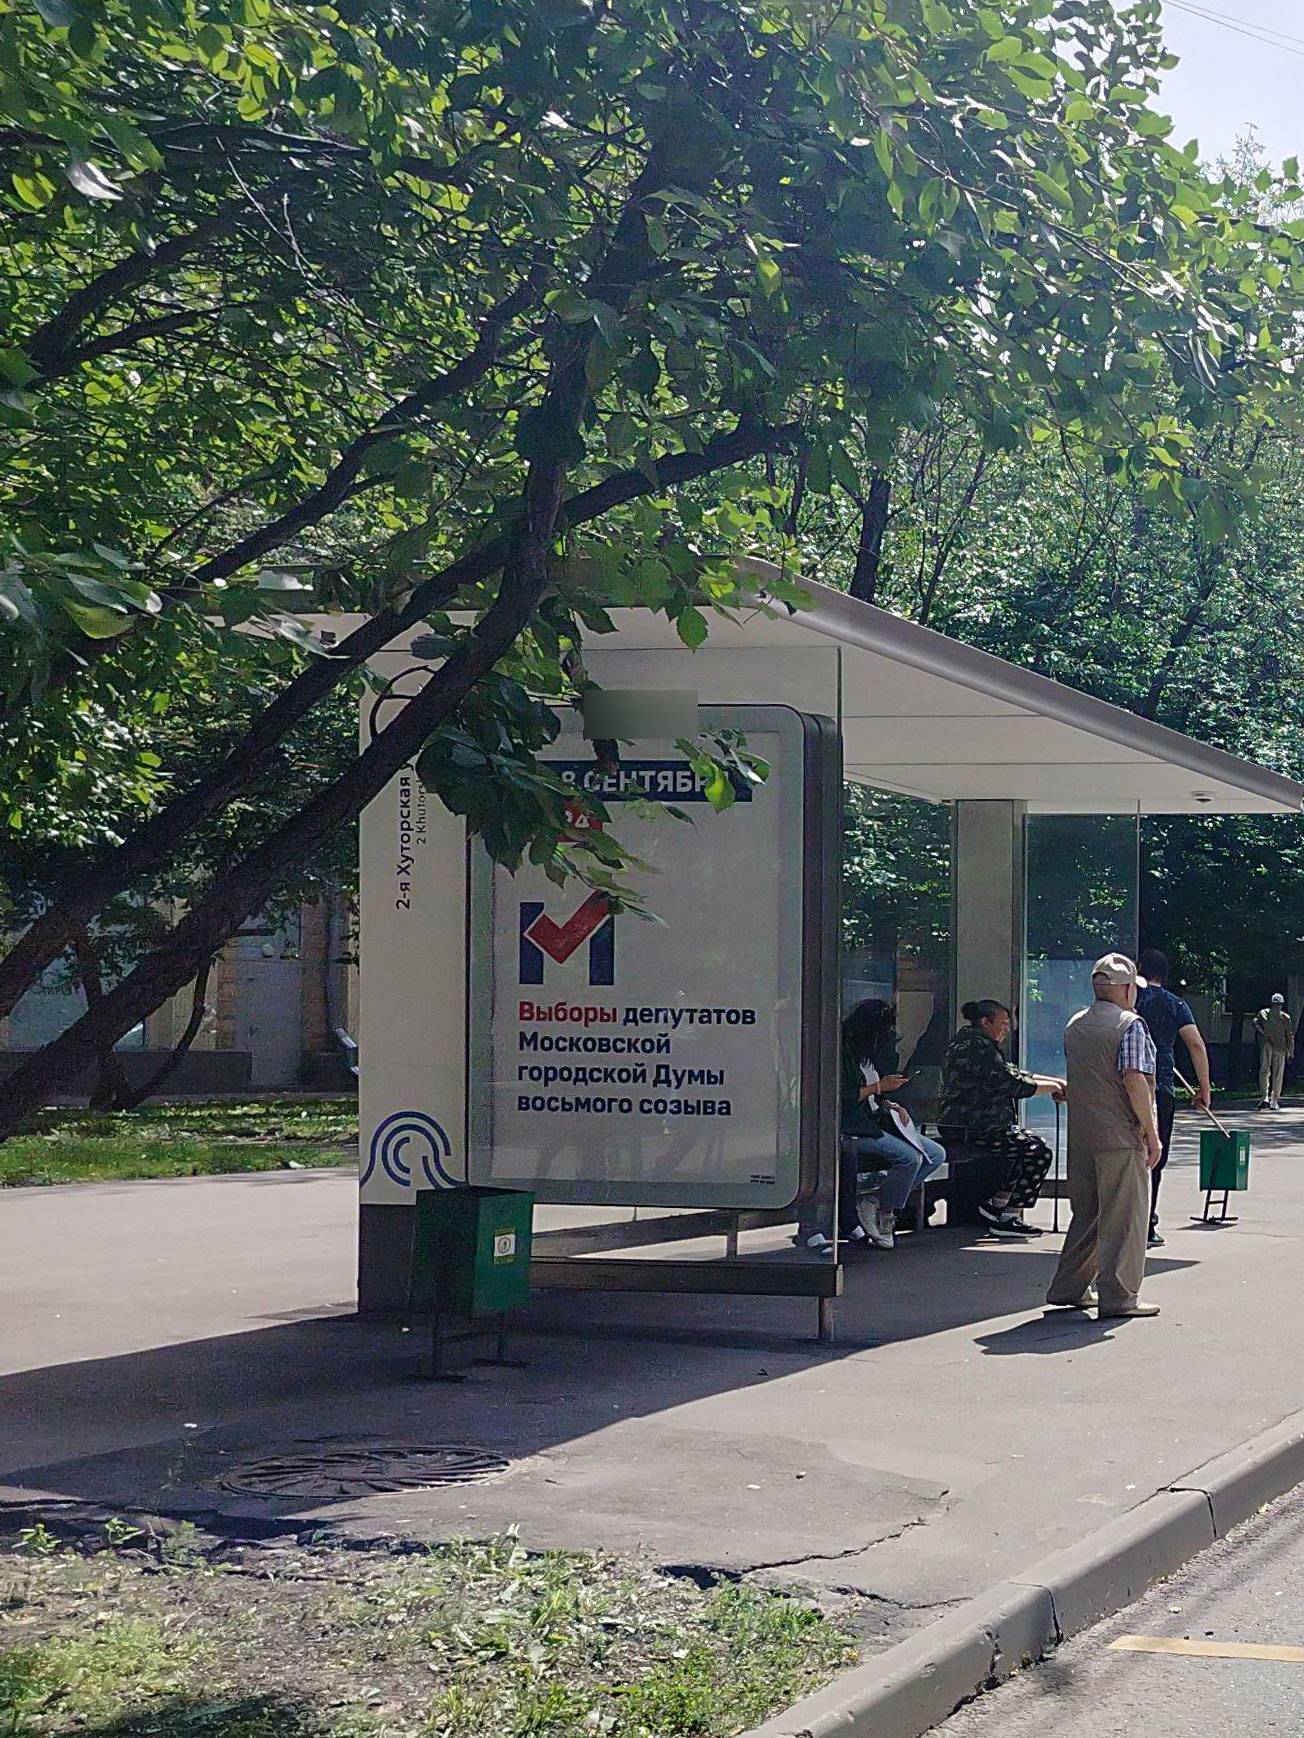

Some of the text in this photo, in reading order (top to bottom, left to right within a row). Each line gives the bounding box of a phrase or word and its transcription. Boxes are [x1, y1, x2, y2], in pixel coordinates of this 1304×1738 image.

[583, 769, 729, 793] СЕНТЯБР
[397, 776, 414, 876] Хуторская
[416, 837, 426, 845] 2
[396, 882, 410, 910] 2-я
[518, 1001, 756, 1029] Выборы депутатов
[518, 1031, 671, 1054] Московской
[517, 1062, 725, 1089] городской Думы
[517, 1095, 732, 1116] восьмого созыва
